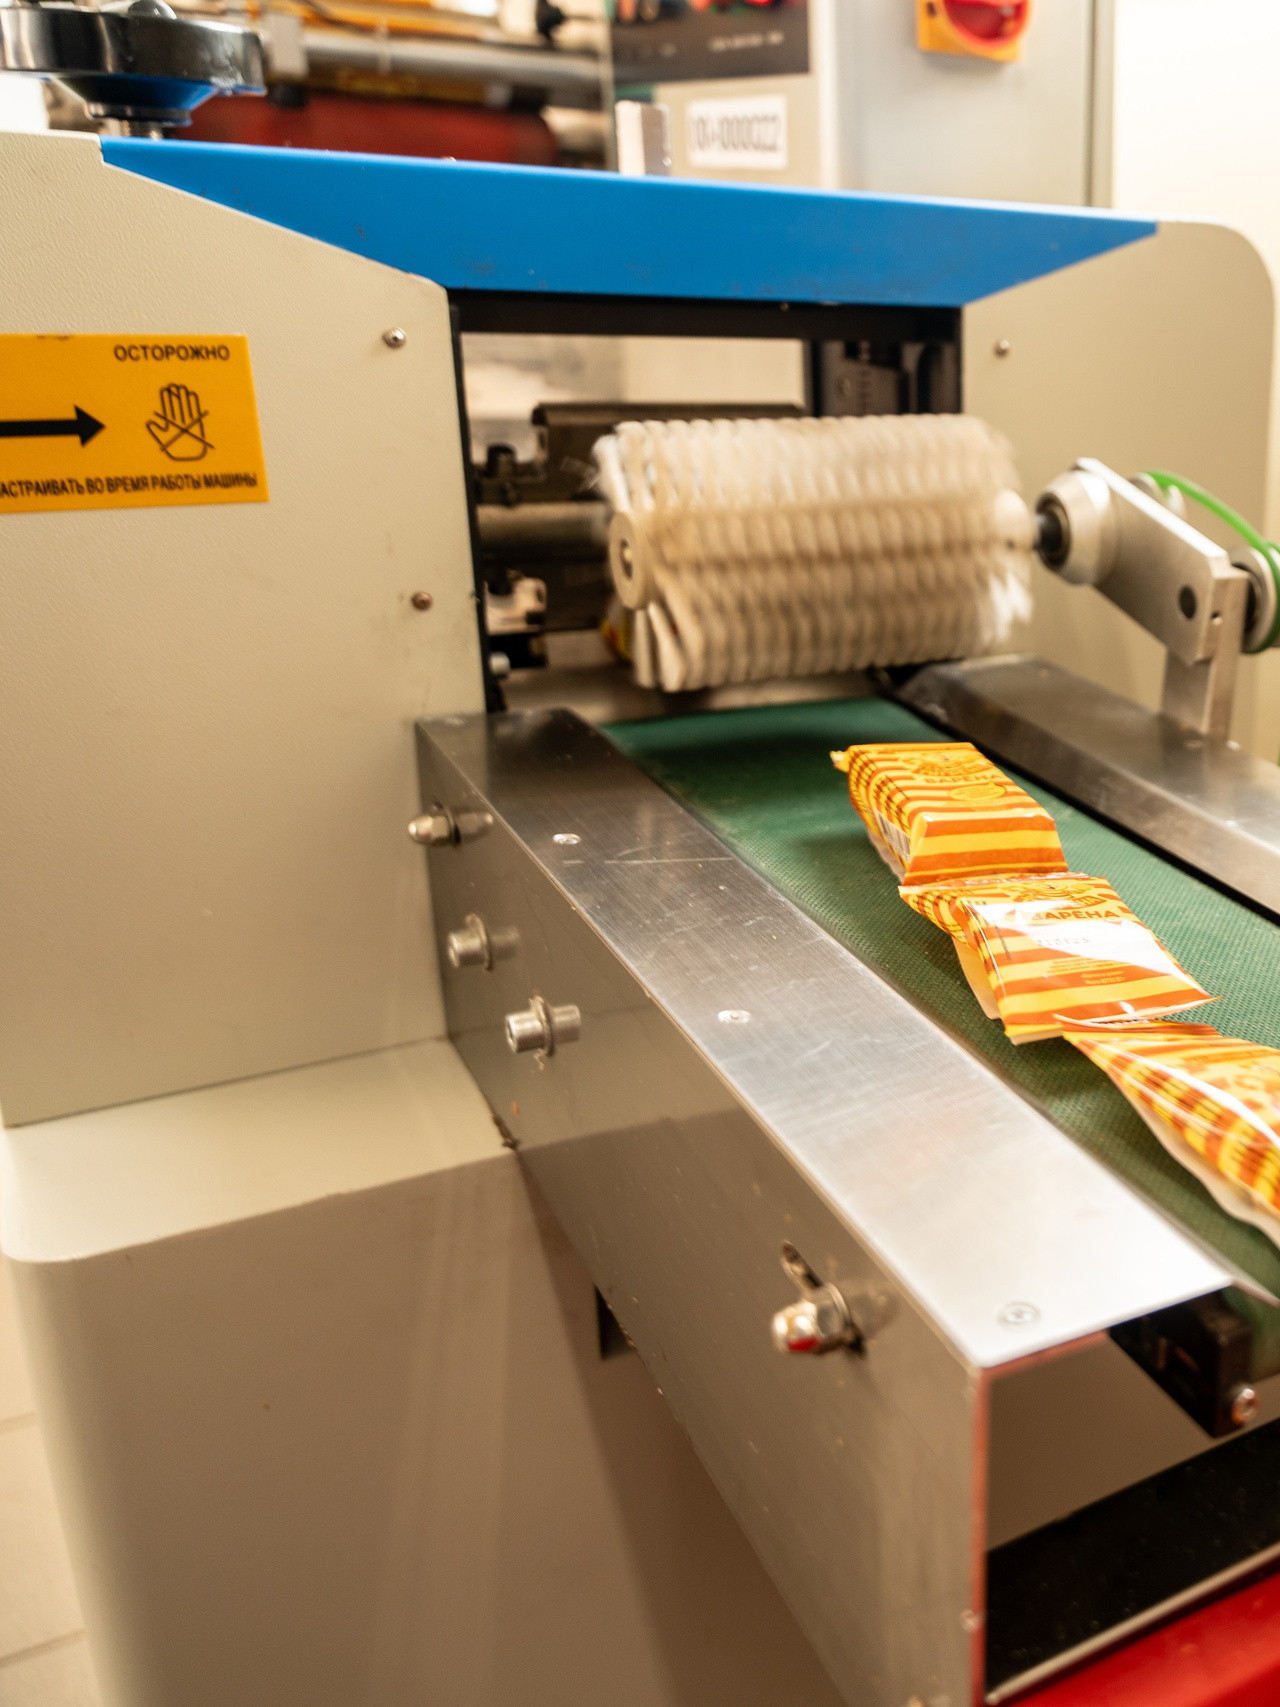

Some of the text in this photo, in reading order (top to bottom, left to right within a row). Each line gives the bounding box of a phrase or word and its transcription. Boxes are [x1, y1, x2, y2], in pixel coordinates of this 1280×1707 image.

[113, 344, 230, 361] ОСТОРОЖНО
[85, 477, 104, 495] ВО
[105, 475, 149, 494] ВРЕМЯ
[151, 473, 201, 491] РАБОТЫ
[203, 472, 258, 489] МАШИНЫ
